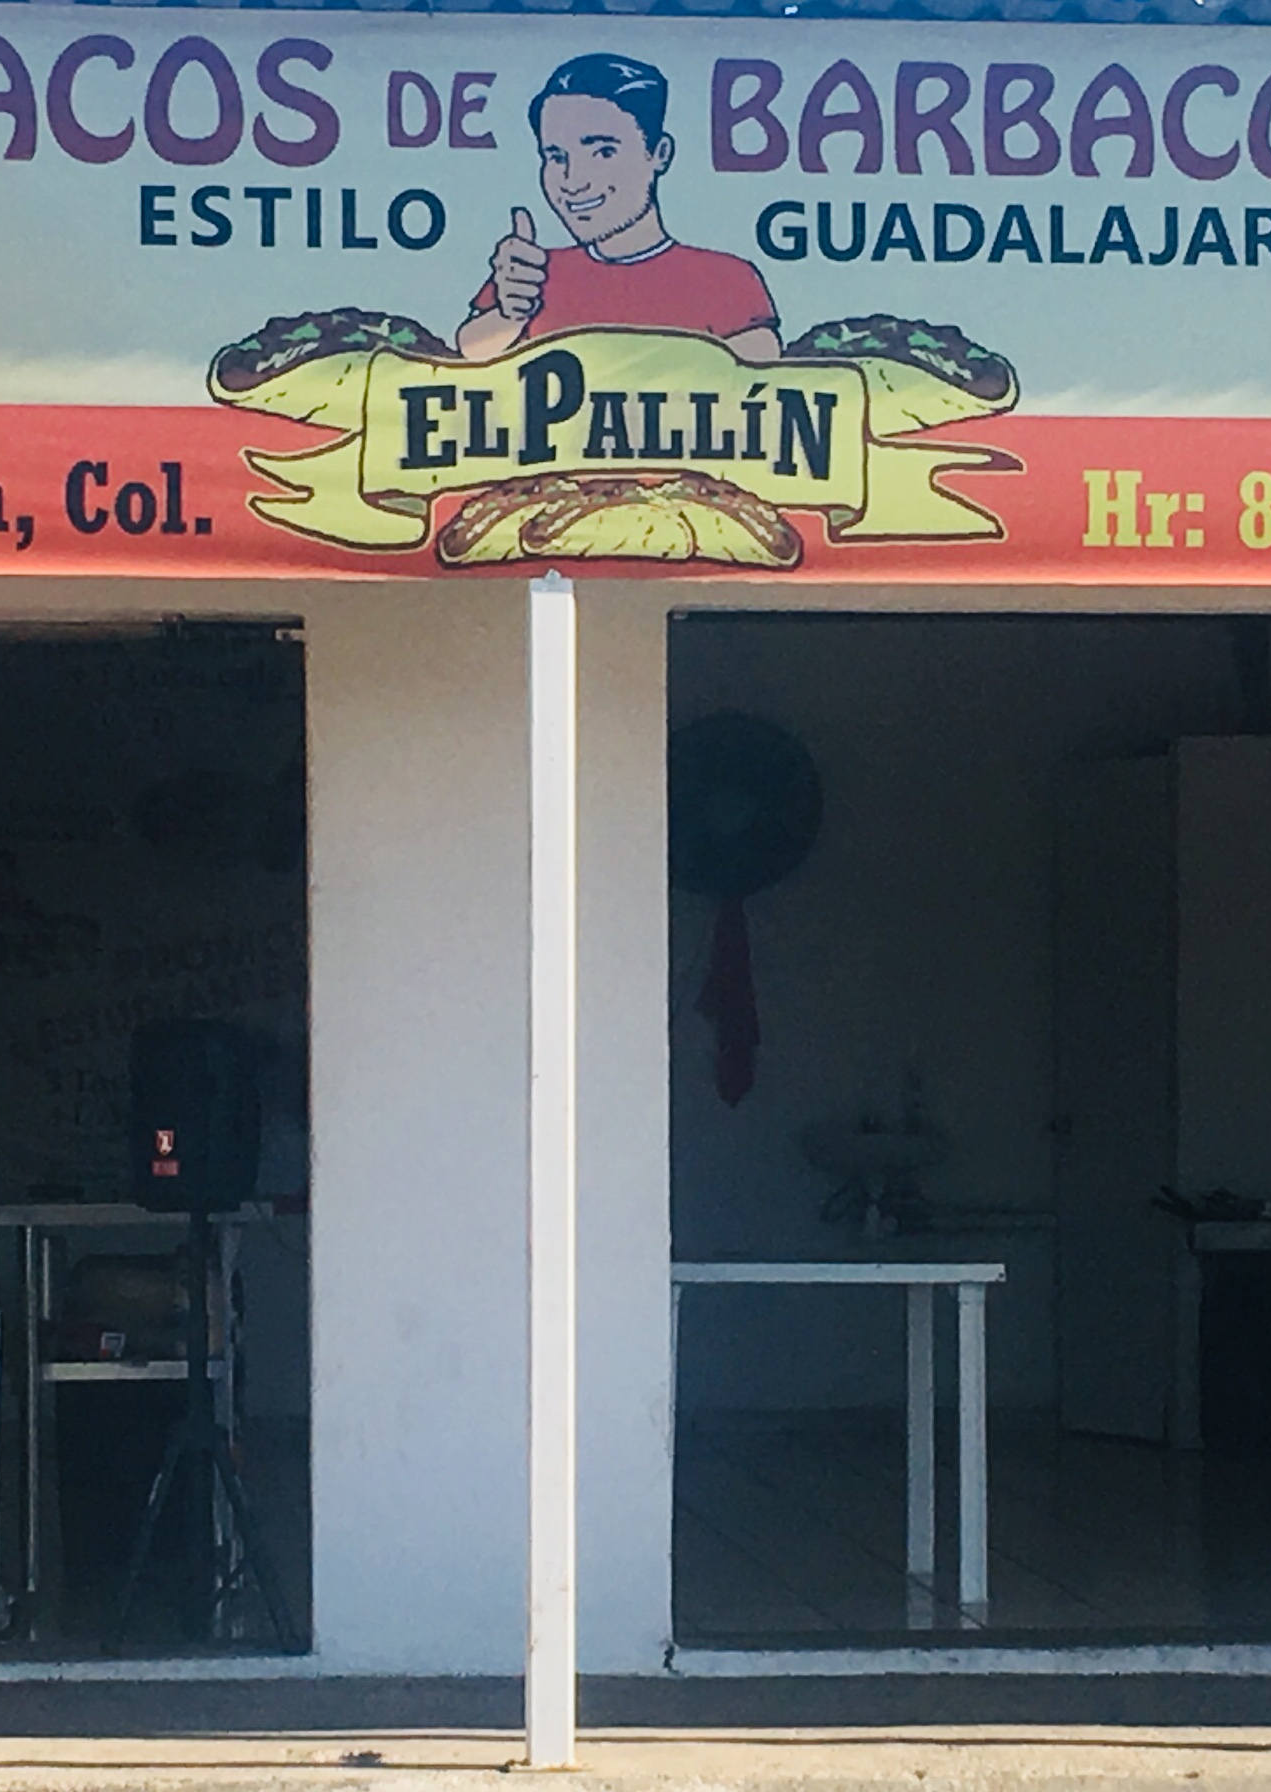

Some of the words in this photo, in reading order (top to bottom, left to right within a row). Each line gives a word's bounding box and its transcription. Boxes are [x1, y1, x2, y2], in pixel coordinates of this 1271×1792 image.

[385, 69, 498, 151] DE
[138, 184, 447, 251] ESTILO
[64, 458, 214, 536] Col.
[1081, 469, 1205, 548] Hr:
